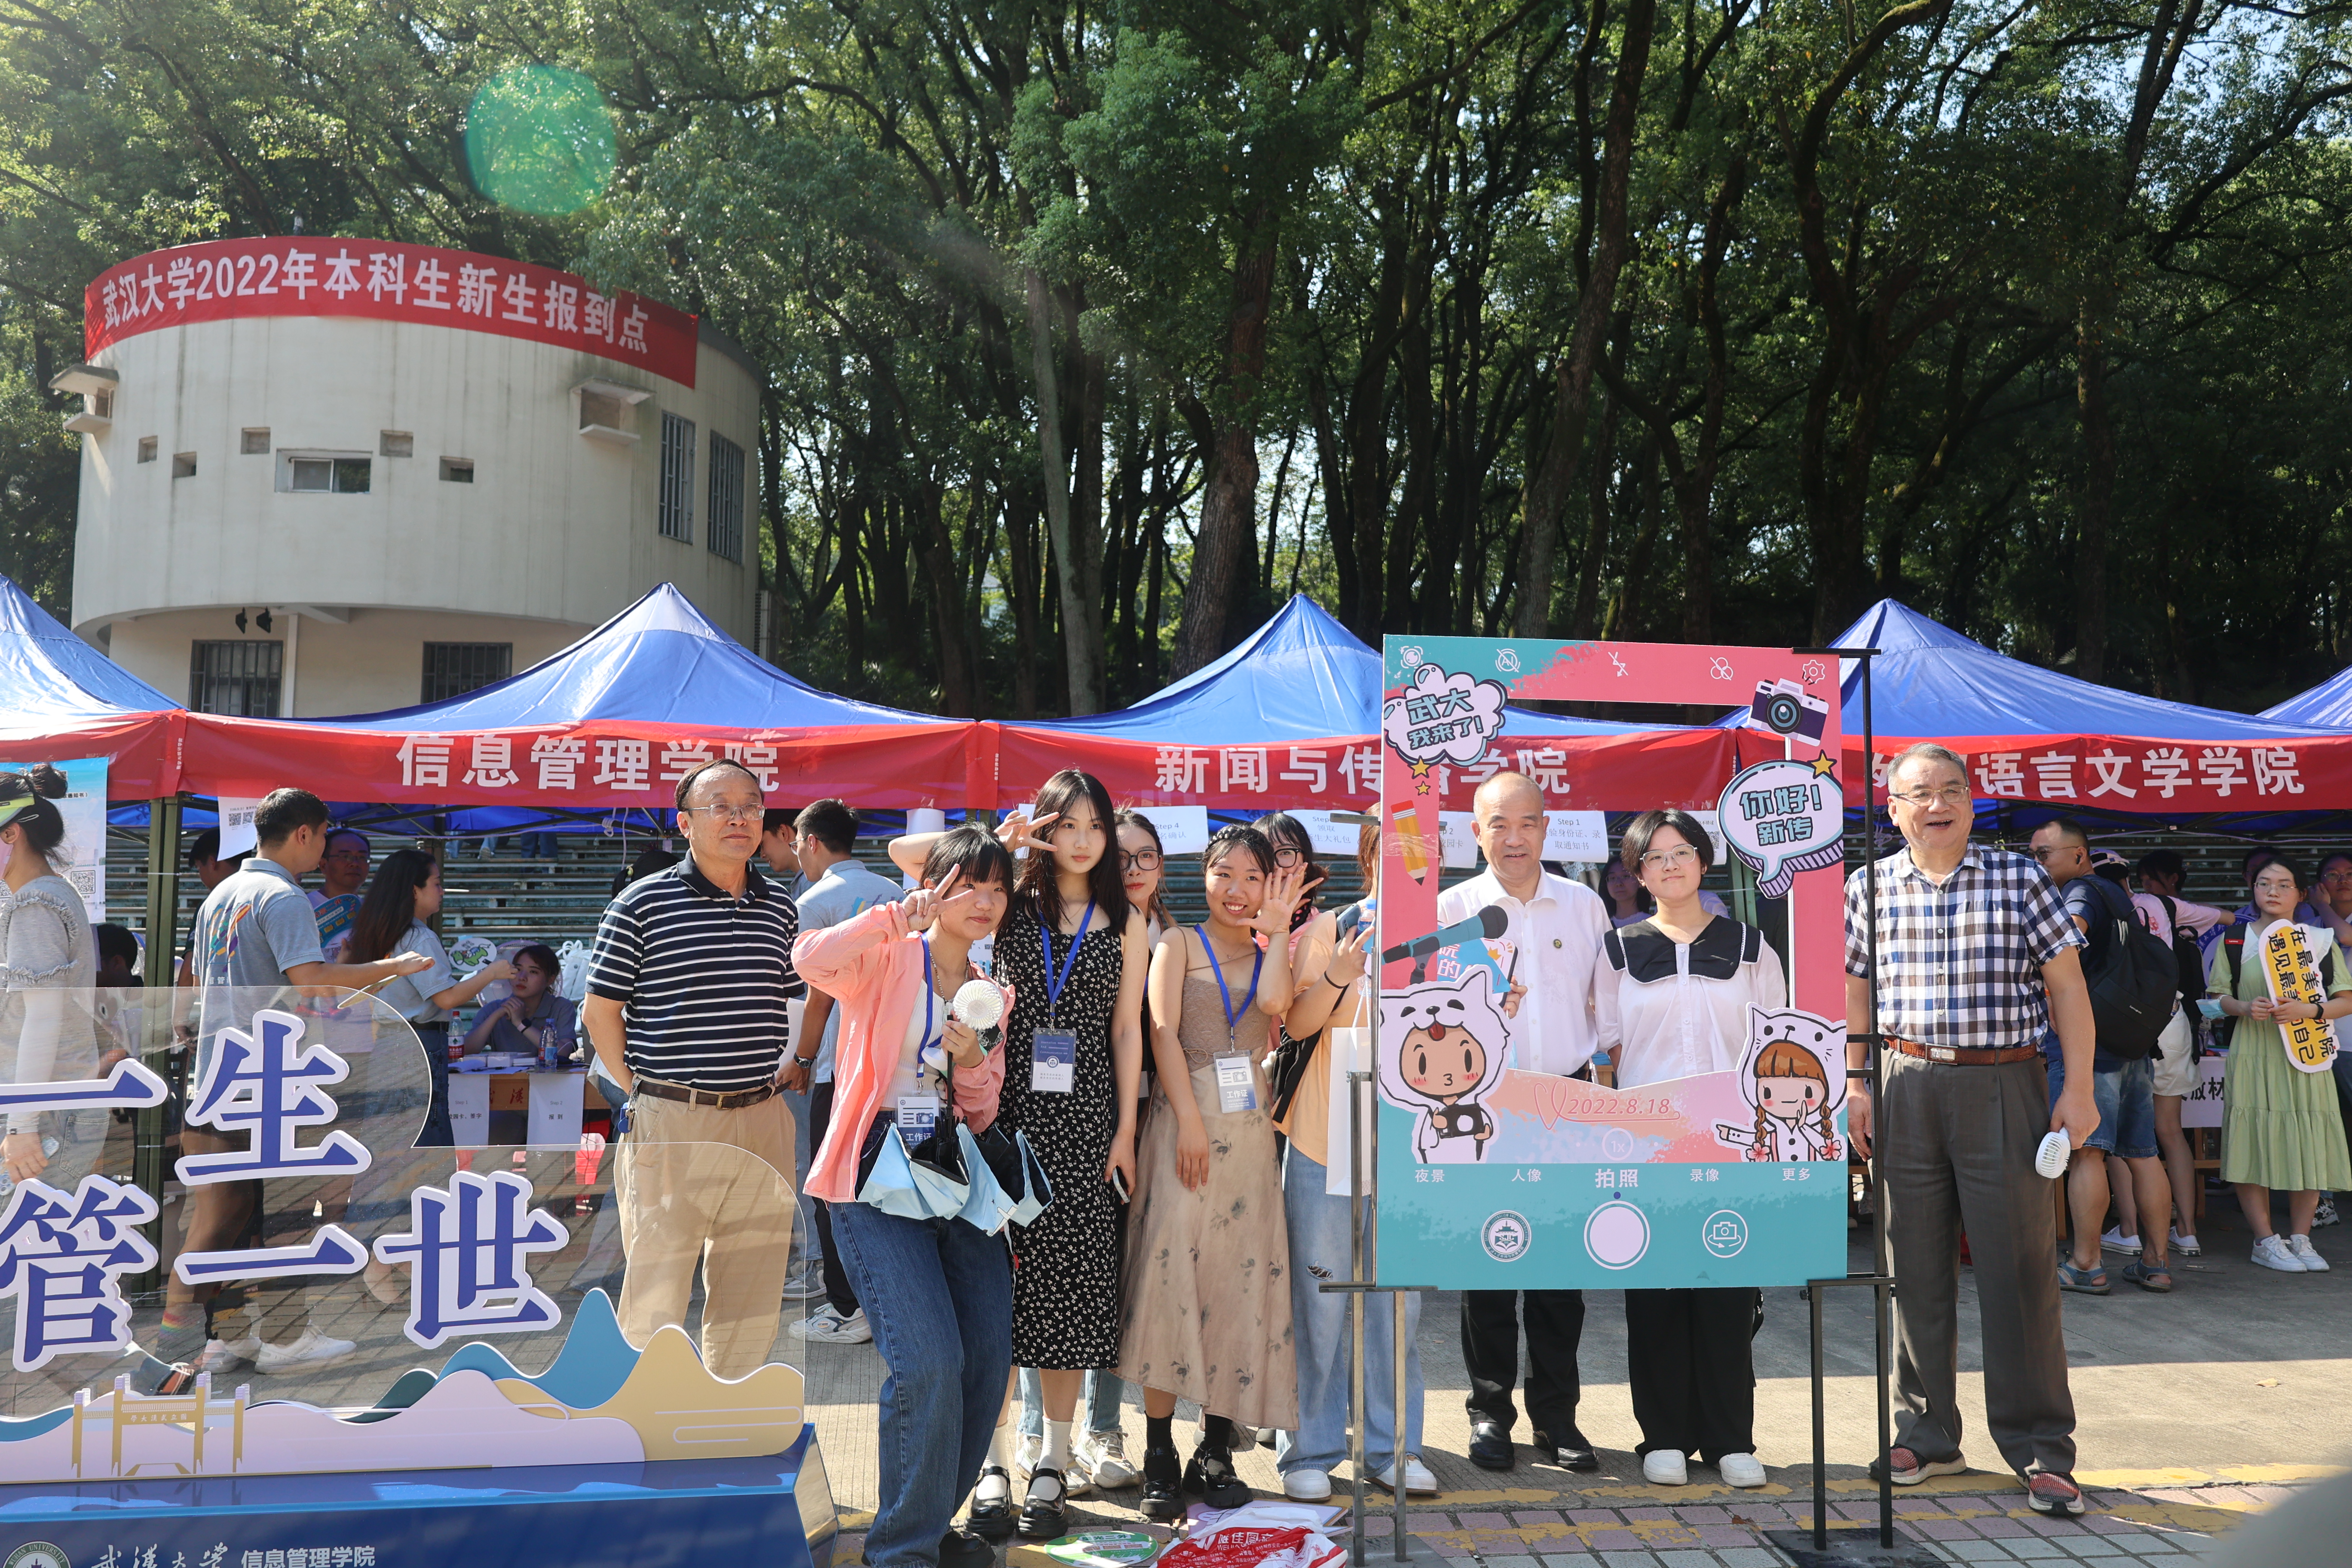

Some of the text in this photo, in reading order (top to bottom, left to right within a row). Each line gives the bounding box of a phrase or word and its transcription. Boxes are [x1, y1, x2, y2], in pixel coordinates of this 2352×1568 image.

[102, 248, 649, 354] 武汉大学2022年本科生新生报到点
[1406, 688, 1474, 726] 武大
[396, 734, 779, 792] 信息管理学院
[1756, 817, 1813, 846] 新传
[1555, 841, 1589, 850] 取通知书
[1227, 1090, 1248, 1098] 工作证
[1567, 1098, 1670, 1115] 2022.8.18
[1611, 1141, 1625, 1153] 1x
[1415, 1167, 1811, 1188] 夜景 人像 拍照 录像 更多
[8, 1544, 66, 1566] WUHAN UNIVERSITY
[241, 1545, 375, 1568] 信息管理学院
